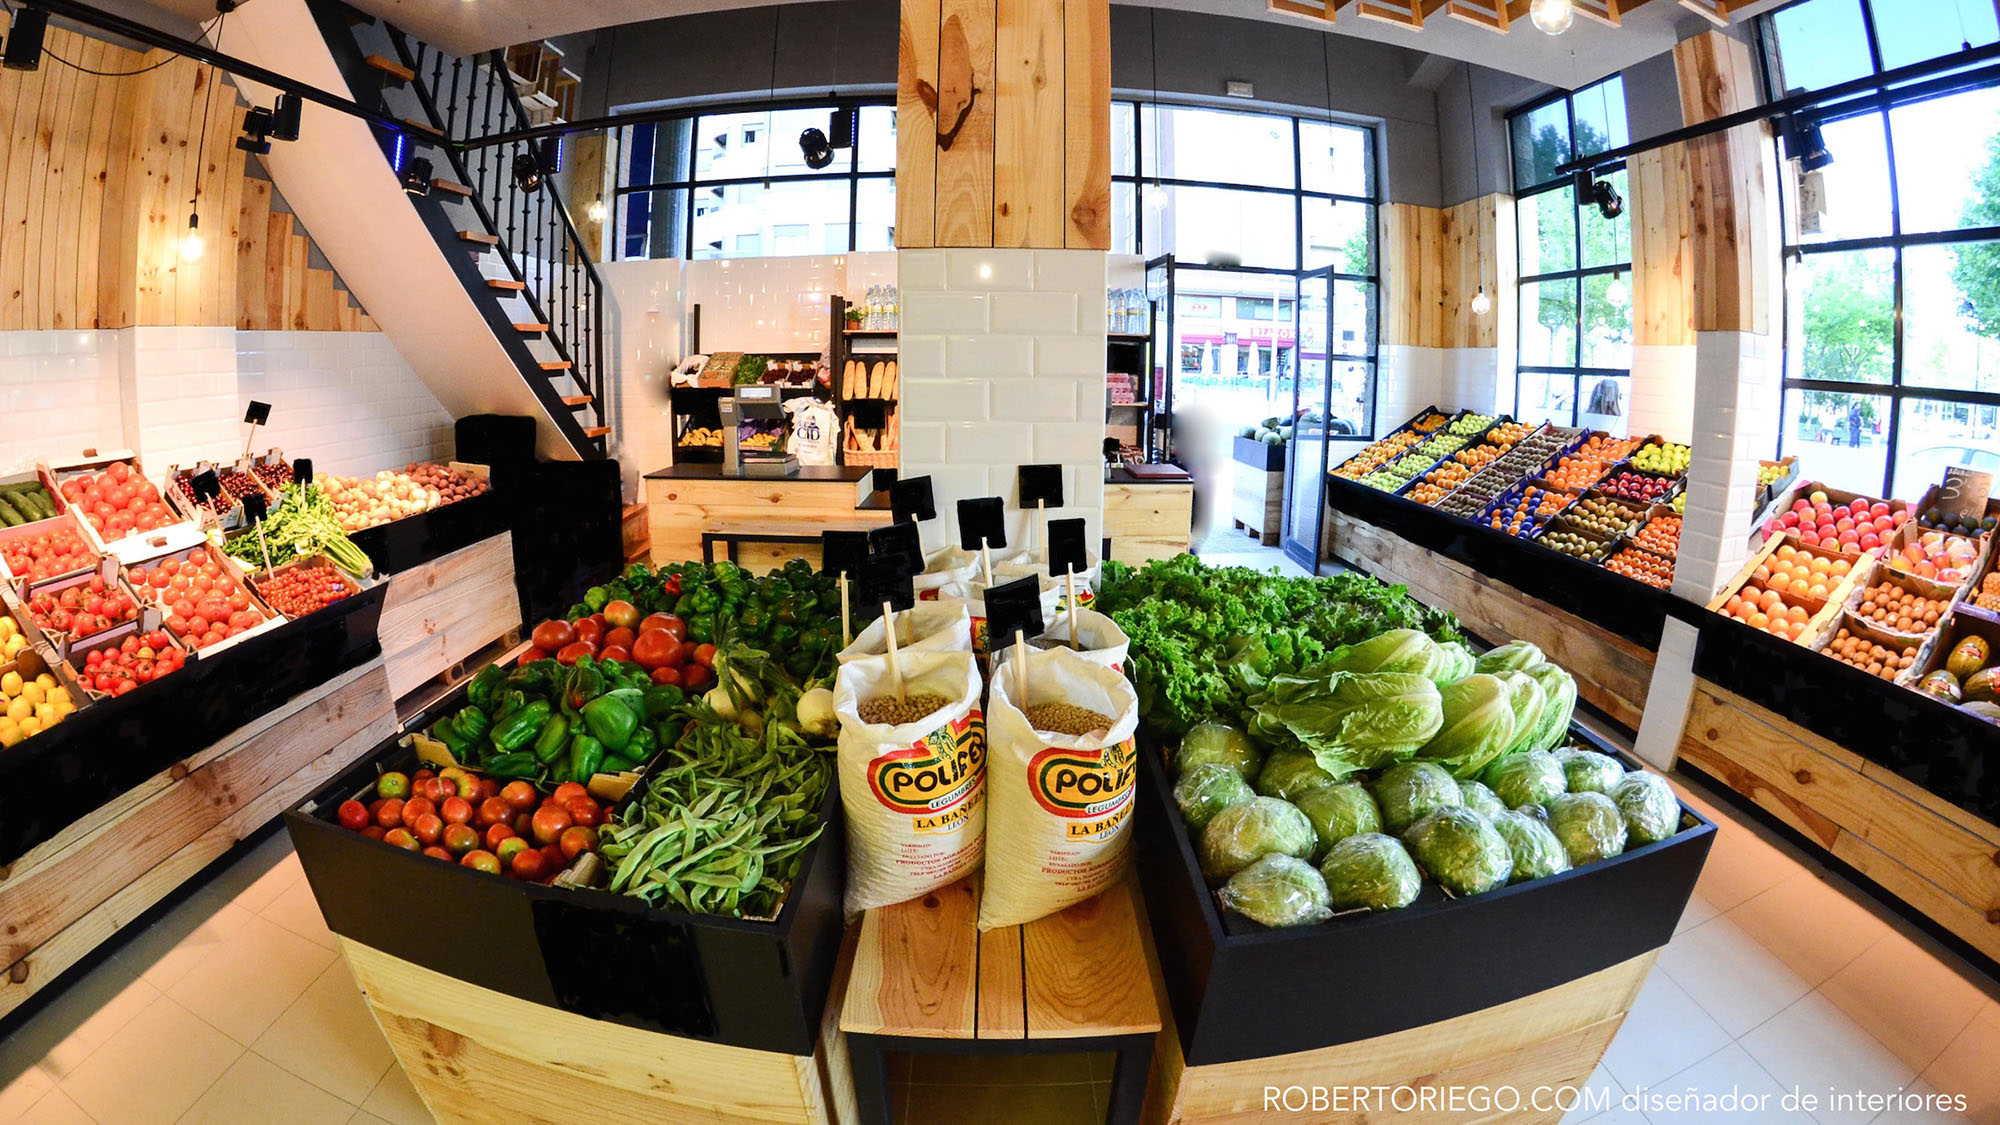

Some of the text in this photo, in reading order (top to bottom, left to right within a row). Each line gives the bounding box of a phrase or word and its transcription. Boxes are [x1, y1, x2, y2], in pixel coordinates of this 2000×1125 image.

[930, 775, 977, 810] LEGUMBRES
[916, 819, 936, 829] LA
[1071, 825, 1091, 836] LA
